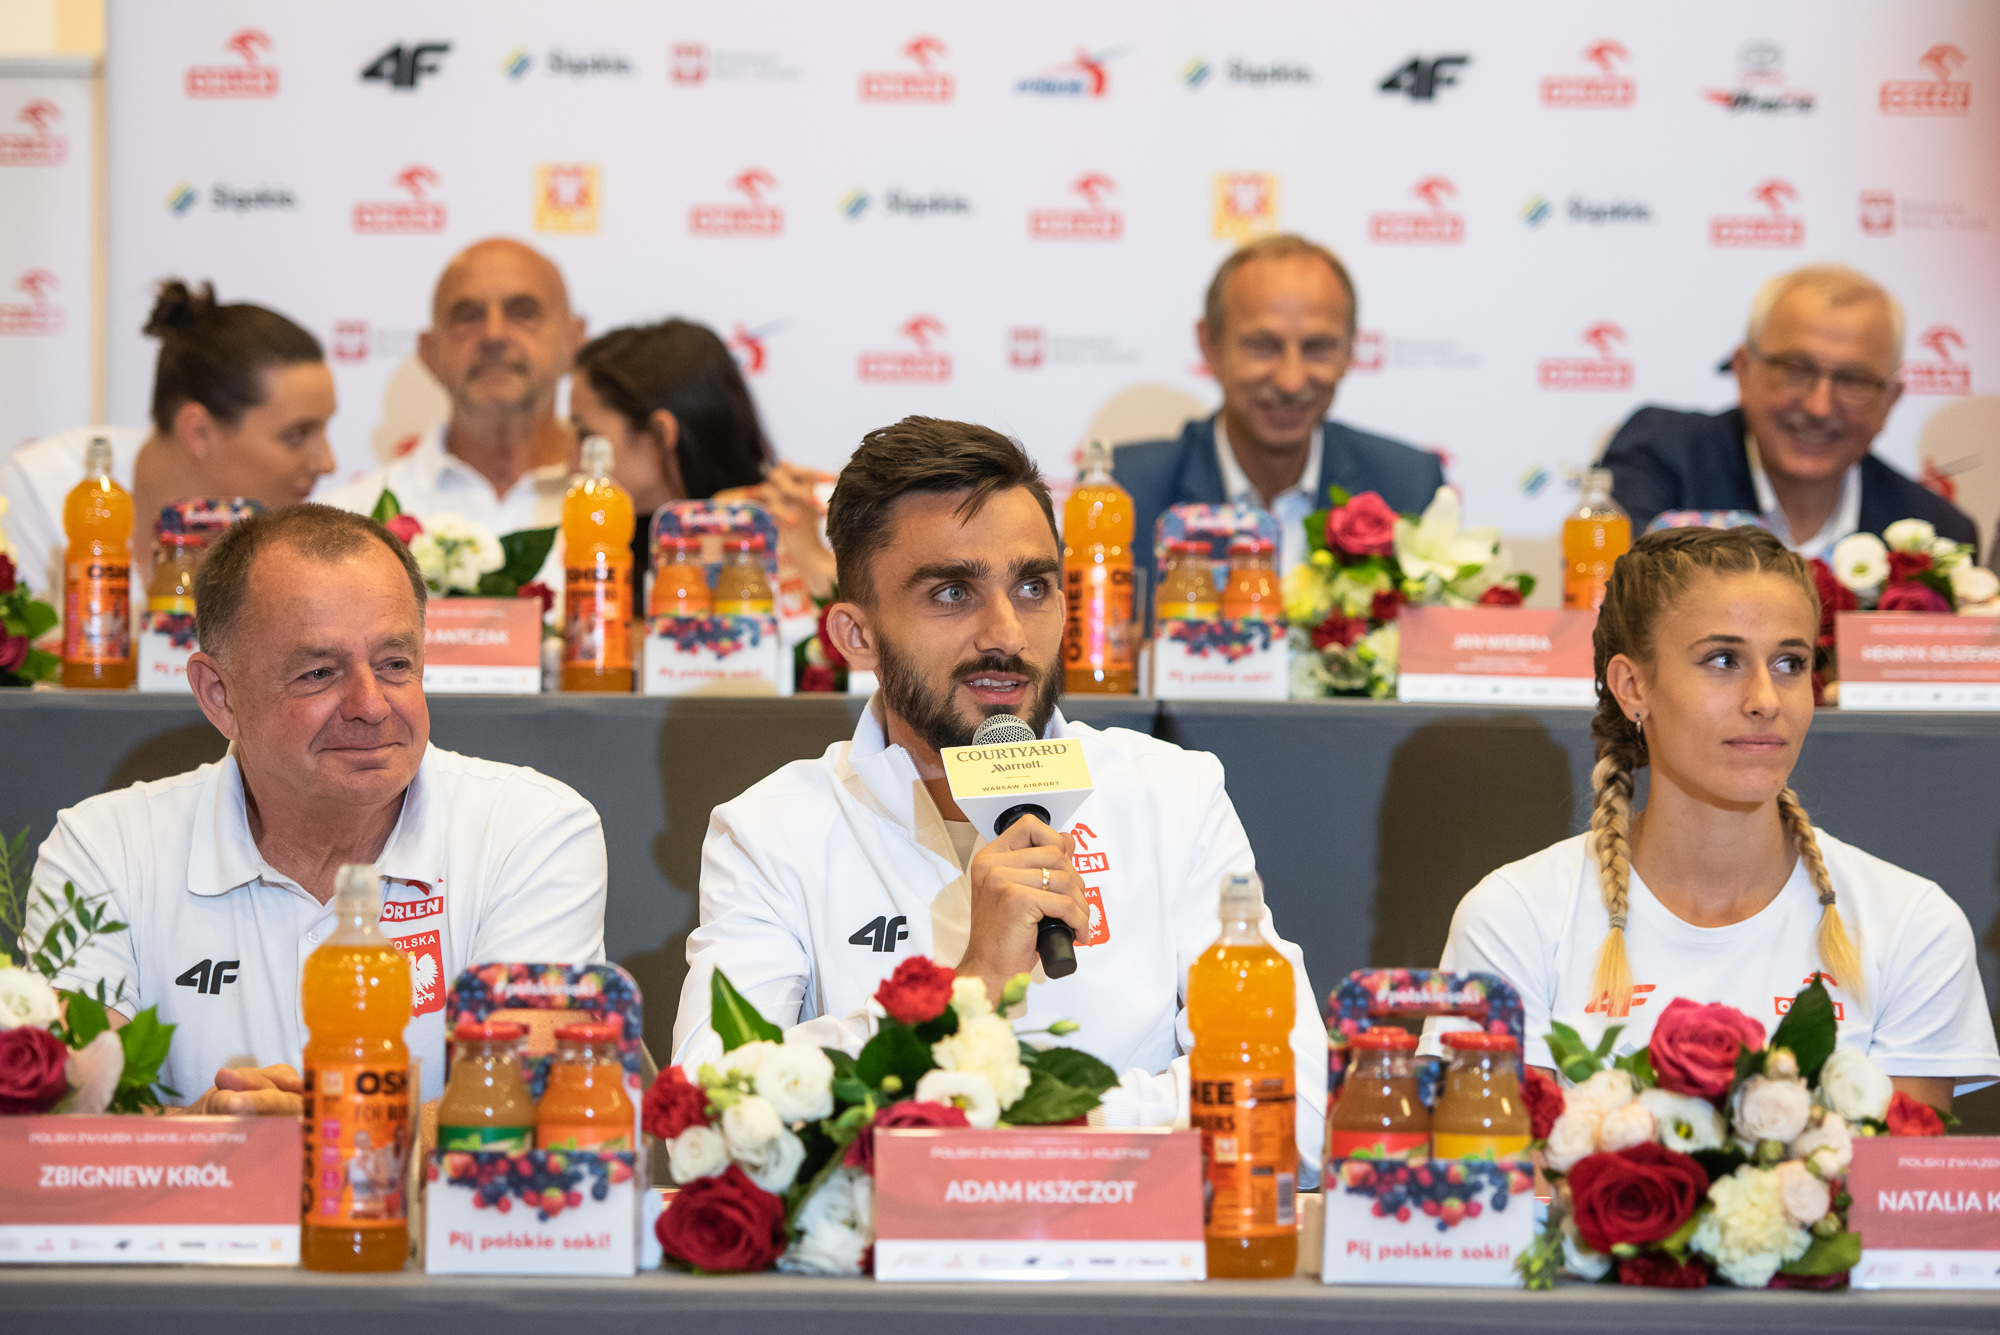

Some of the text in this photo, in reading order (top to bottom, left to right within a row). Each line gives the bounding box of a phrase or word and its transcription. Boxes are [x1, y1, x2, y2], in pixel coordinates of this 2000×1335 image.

[360, 43, 454, 91] 4F
[1378, 54, 1472, 102] 4F
[956, 743, 1068, 762] COURTYARD
[991, 760, 1041, 773] Marriott
[982, 781, 1060, 792] WARSAW AIRPORT
[1071, 854, 1105, 872] LEN
[382, 898, 440, 919] ORLEN
[393, 934, 436, 950] OLSKA
[848, 915, 909, 952] 4F
[175, 958, 240, 995] 4F
[39, 1161, 233, 1188] ZBIGNIEW KRÓL
[945, 1180, 1138, 1204] ADAM KSZCZOT
[1878, 1190, 1983, 1212] NATALIA
[448, 1230, 473, 1252] Pij
[480, 1230, 554, 1252] polskie
[1346, 1240, 1370, 1261] Pij
[1378, 1241, 1453, 1262] polskie
